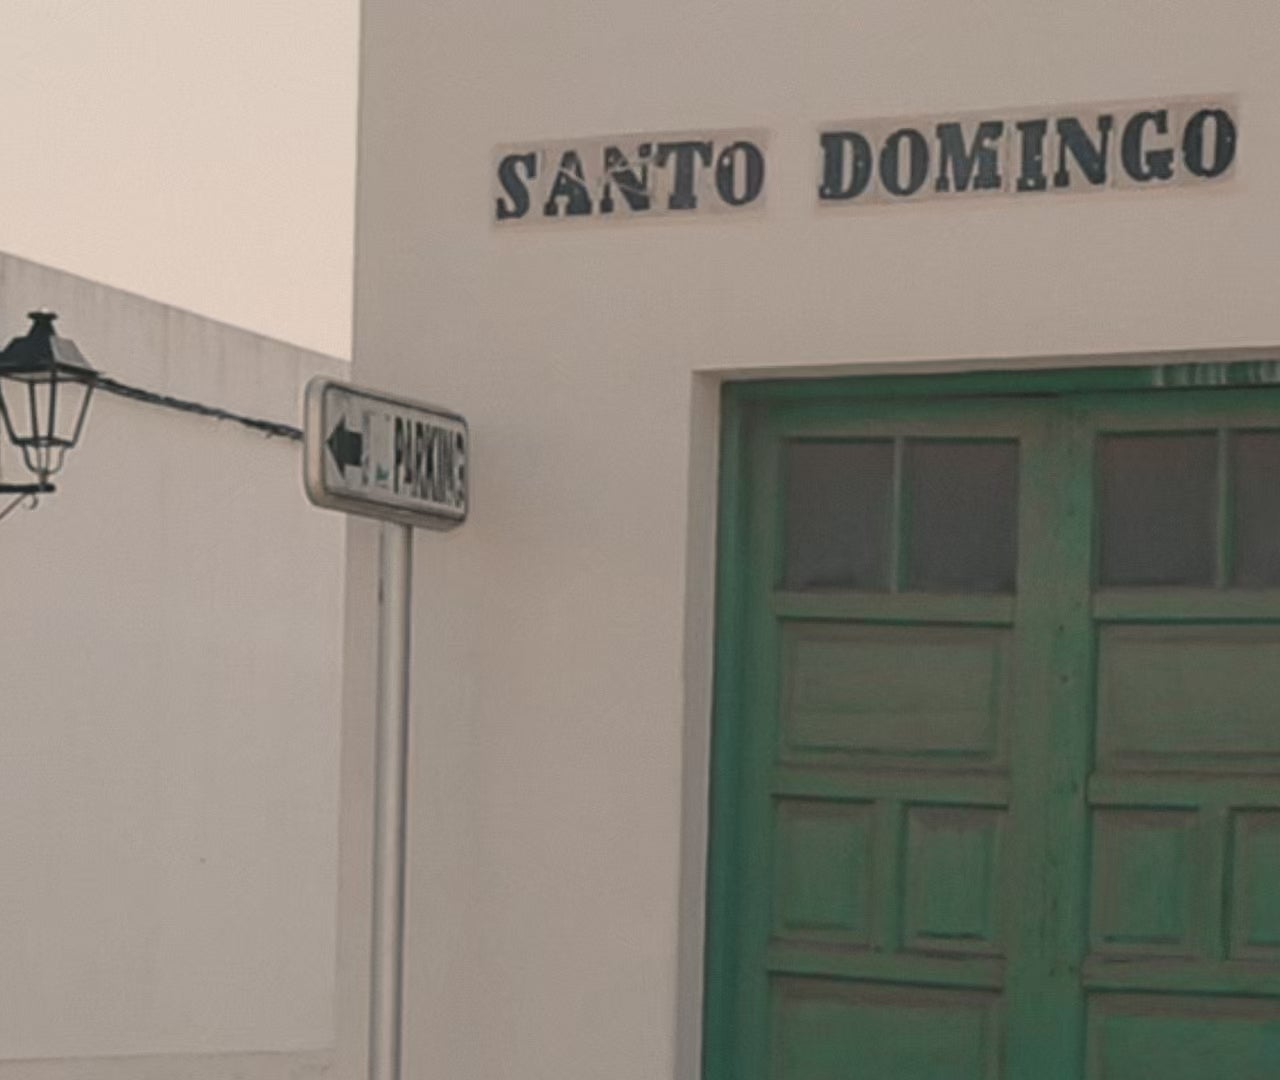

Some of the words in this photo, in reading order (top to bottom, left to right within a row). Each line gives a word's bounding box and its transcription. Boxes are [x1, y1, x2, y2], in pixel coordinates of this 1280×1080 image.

[495, 140, 766, 221] SANTO
[818, 108, 1238, 200] DOMINGO
[393, 415, 466, 508] PARKING
